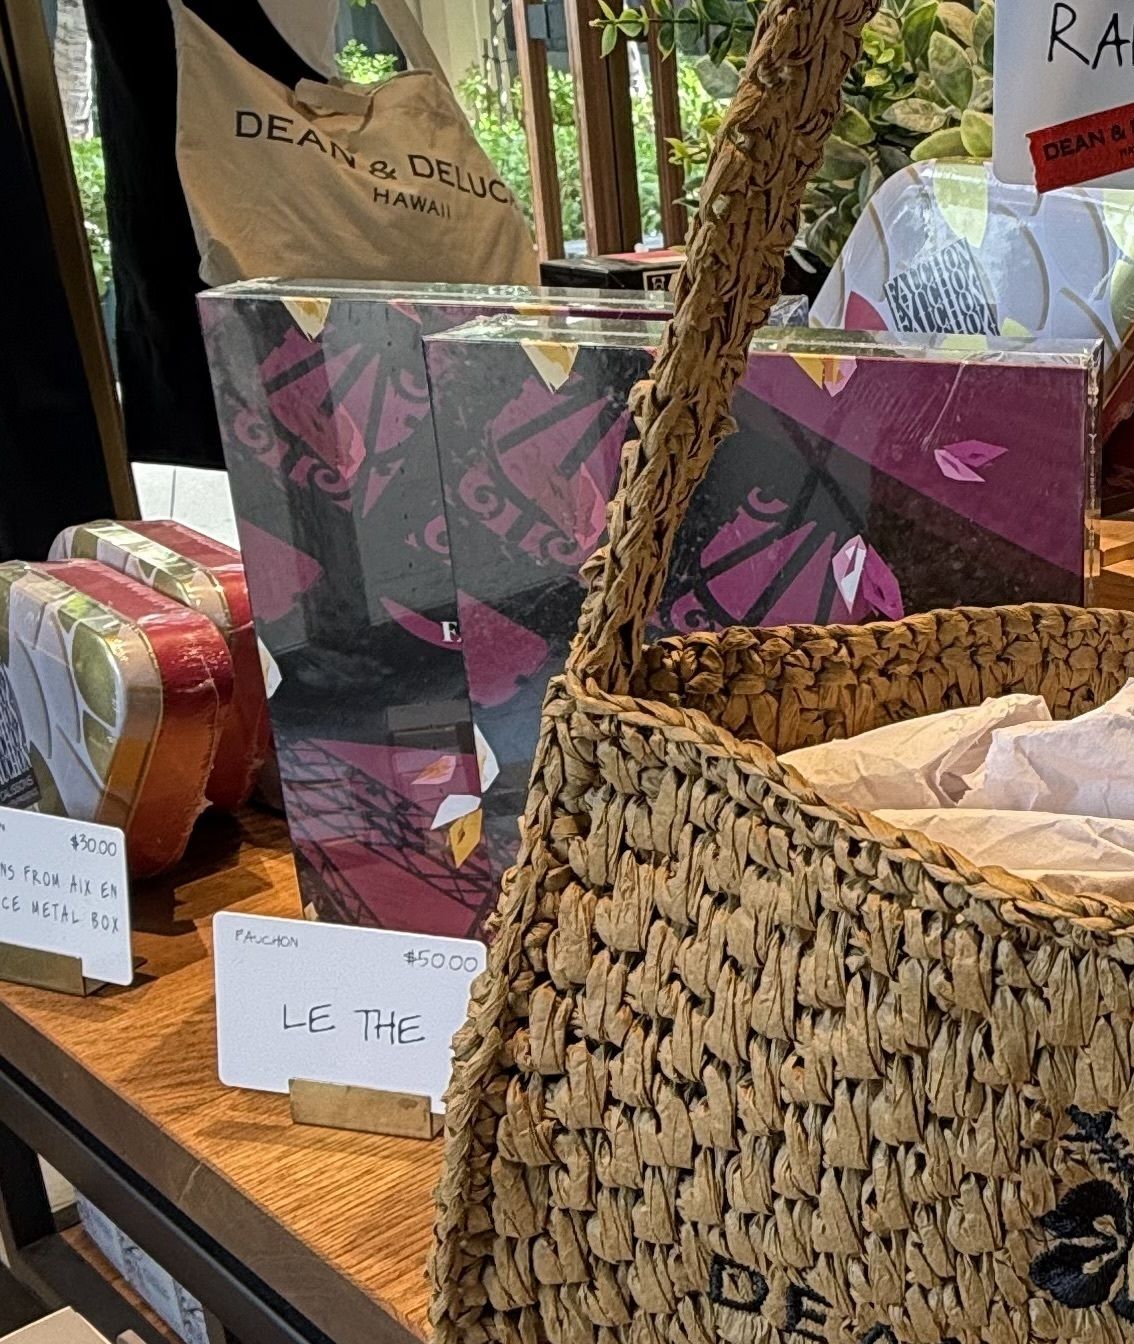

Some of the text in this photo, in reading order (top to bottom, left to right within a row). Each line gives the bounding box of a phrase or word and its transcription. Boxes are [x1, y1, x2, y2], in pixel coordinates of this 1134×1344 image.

[234, 110, 356, 169] DEAN
[368, 160, 398, 180] &
[1043, 127, 1106, 162] DEAN
[1111, 123, 1126, 141] &
[372, 187, 451, 219] HAWAII
[70, 833, 117, 857] $30.00
[24, 865, 60, 889] FROM
[70, 875, 91, 895] AIX
[101, 881, 118, 899] EN
[31, 900, 79, 924] METAL
[91, 912, 119, 934] BOX
[403, 949, 478, 973] $50.00
[283, 1004, 425, 1045] LE THE
